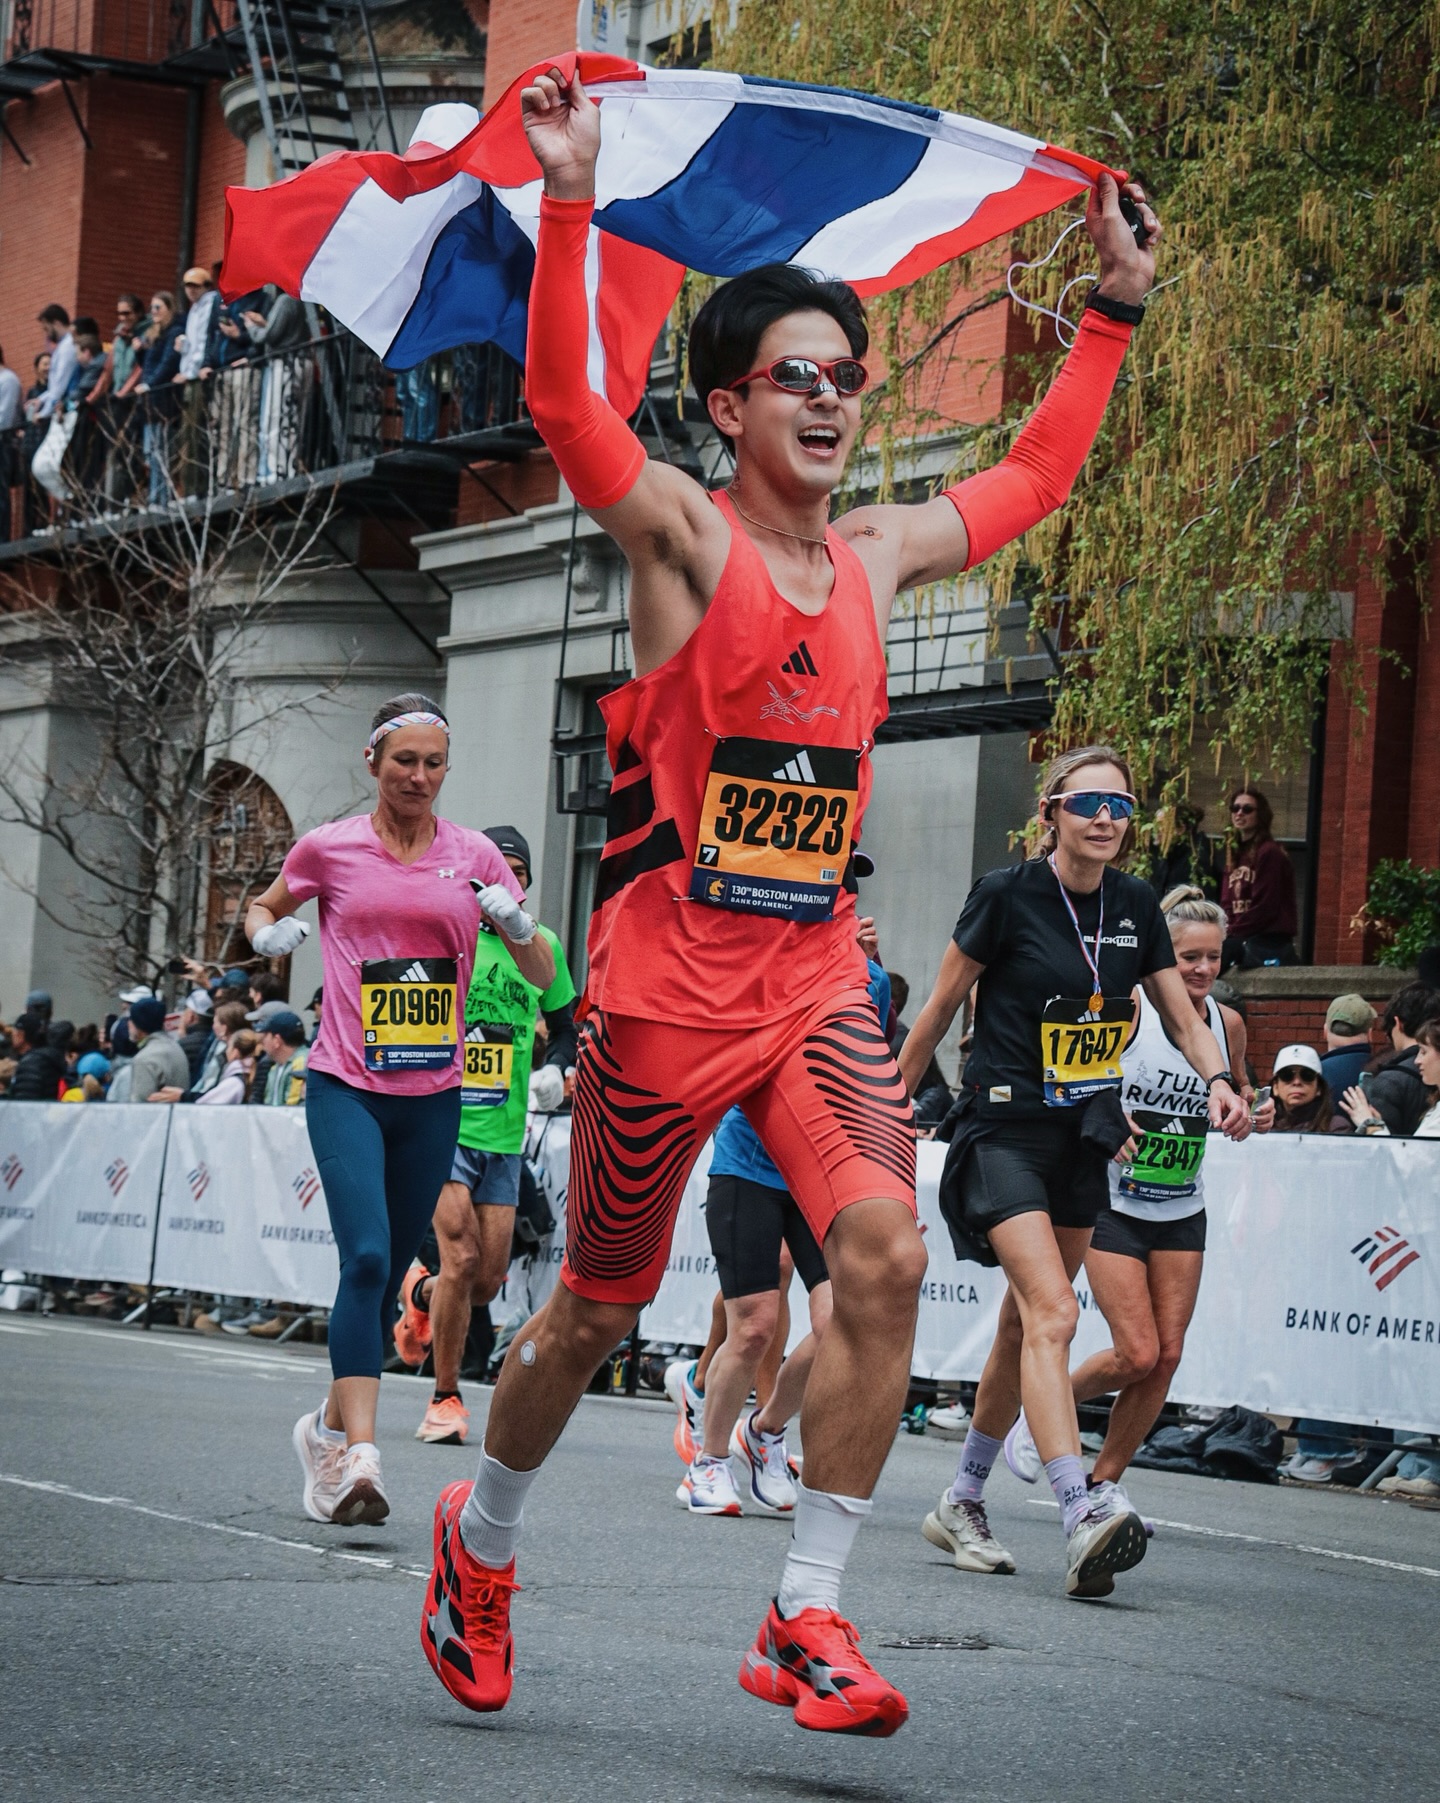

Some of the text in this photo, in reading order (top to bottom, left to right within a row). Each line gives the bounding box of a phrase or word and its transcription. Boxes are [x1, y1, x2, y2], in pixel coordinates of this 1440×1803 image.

[714, 783, 848, 856] 32323
[702, 846, 717, 864] 7
[730, 896, 793, 910] BANK OF AMERICA
[752, 887, 788, 902] BOSTON
[789, 892, 830, 905] MARATHON
[370, 988, 452, 1026] 20960
[366, 1031, 376, 1042] 8
[1049, 1026, 1123, 1066] 17647
[401, 1051, 424, 1059] BOSTON
[464, 1047, 503, 1075] 351
[1047, 1070, 1056, 1079] 3
[1126, 1084, 1209, 1117] RUNNE
[1132, 1134, 1202, 1171] 22347
[1125, 1166, 1132, 1176] 2
[695, 1257, 710, 1275] OF
[919, 1282, 979, 1305] MERICA
[1285, 1307, 1340, 1334] BANK
[1346, 1313, 1371, 1336] OF
